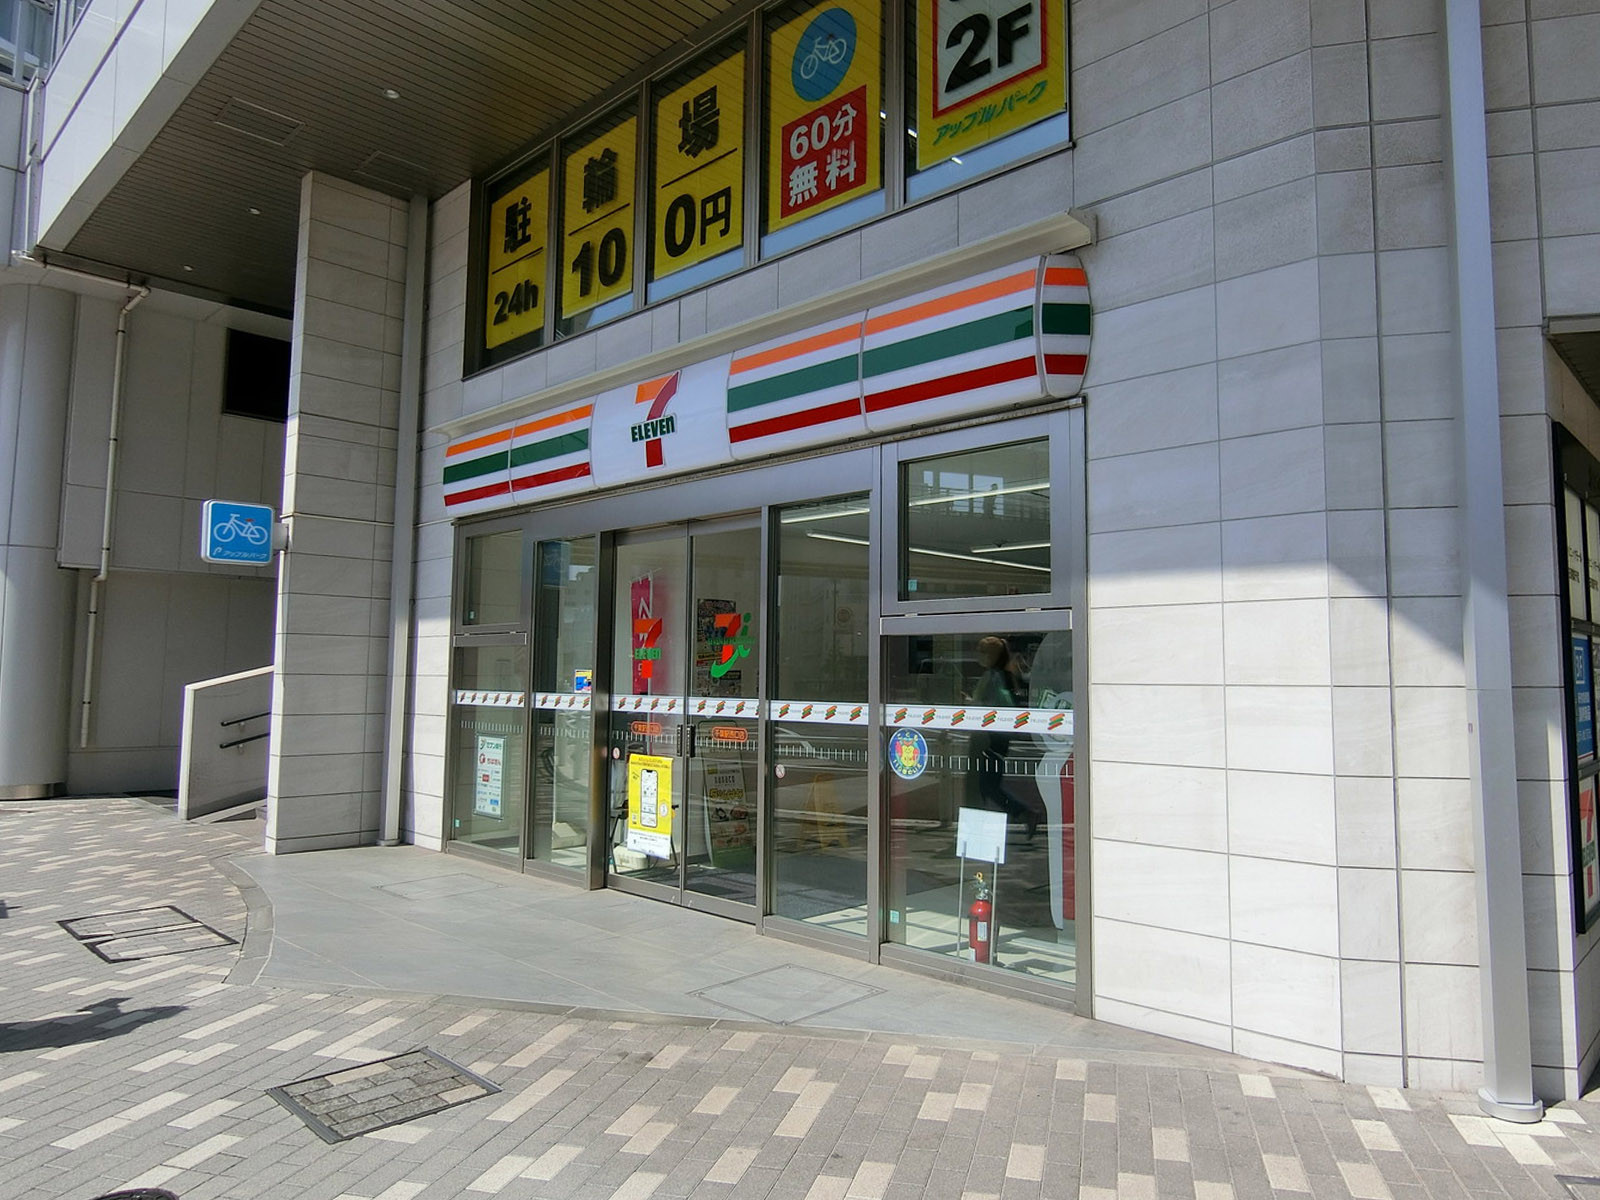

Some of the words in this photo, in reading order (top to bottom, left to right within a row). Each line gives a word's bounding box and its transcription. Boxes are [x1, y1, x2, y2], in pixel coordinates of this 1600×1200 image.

[944, 2, 1032, 93] 2F
[790, 102, 857, 160] 60分
[933, 80, 1048, 146] アップルパーク
[789, 141, 857, 207] 無料
[494, 278, 540, 325] 24h
